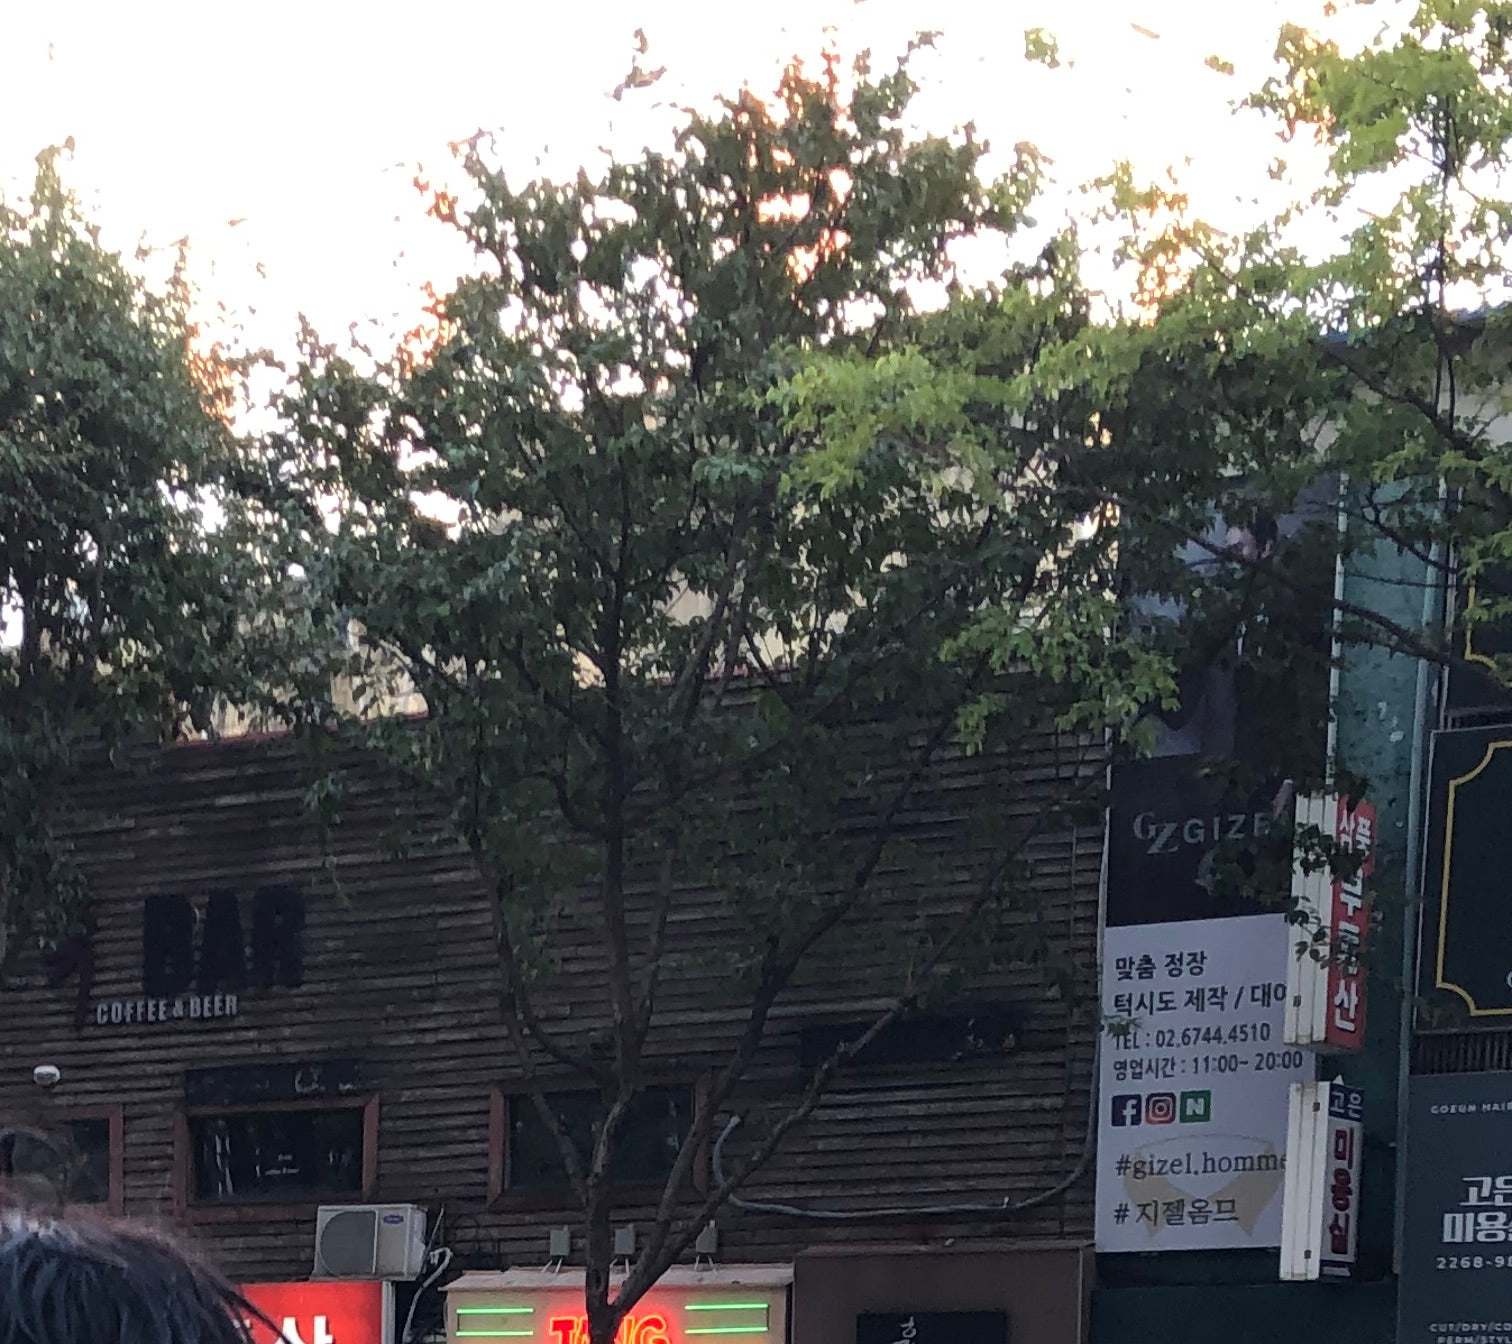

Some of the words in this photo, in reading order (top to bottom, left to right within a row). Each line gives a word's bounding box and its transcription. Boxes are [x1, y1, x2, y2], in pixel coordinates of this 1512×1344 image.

[1115, 956, 1157, 981] 맞춤
[1164, 951, 1207, 977] 정장
[96, 1001, 167, 1025] COFFEE
[190, 994, 237, 1018] BEER
[1114, 990, 1177, 1016] 턱시도
[1184, 986, 1228, 1012] 제작
[1155, 1023, 1270, 1048] 02.6744.4510
[1114, 1056, 1175, 1081] 영업시간
[1255, 1051, 1303, 1071] 20:00
[1330, 1127, 1354, 1255] 미용실
[1136, 1200, 1239, 1226] 지젤옴므
[1442, 1212, 1512, 1243] 미용
